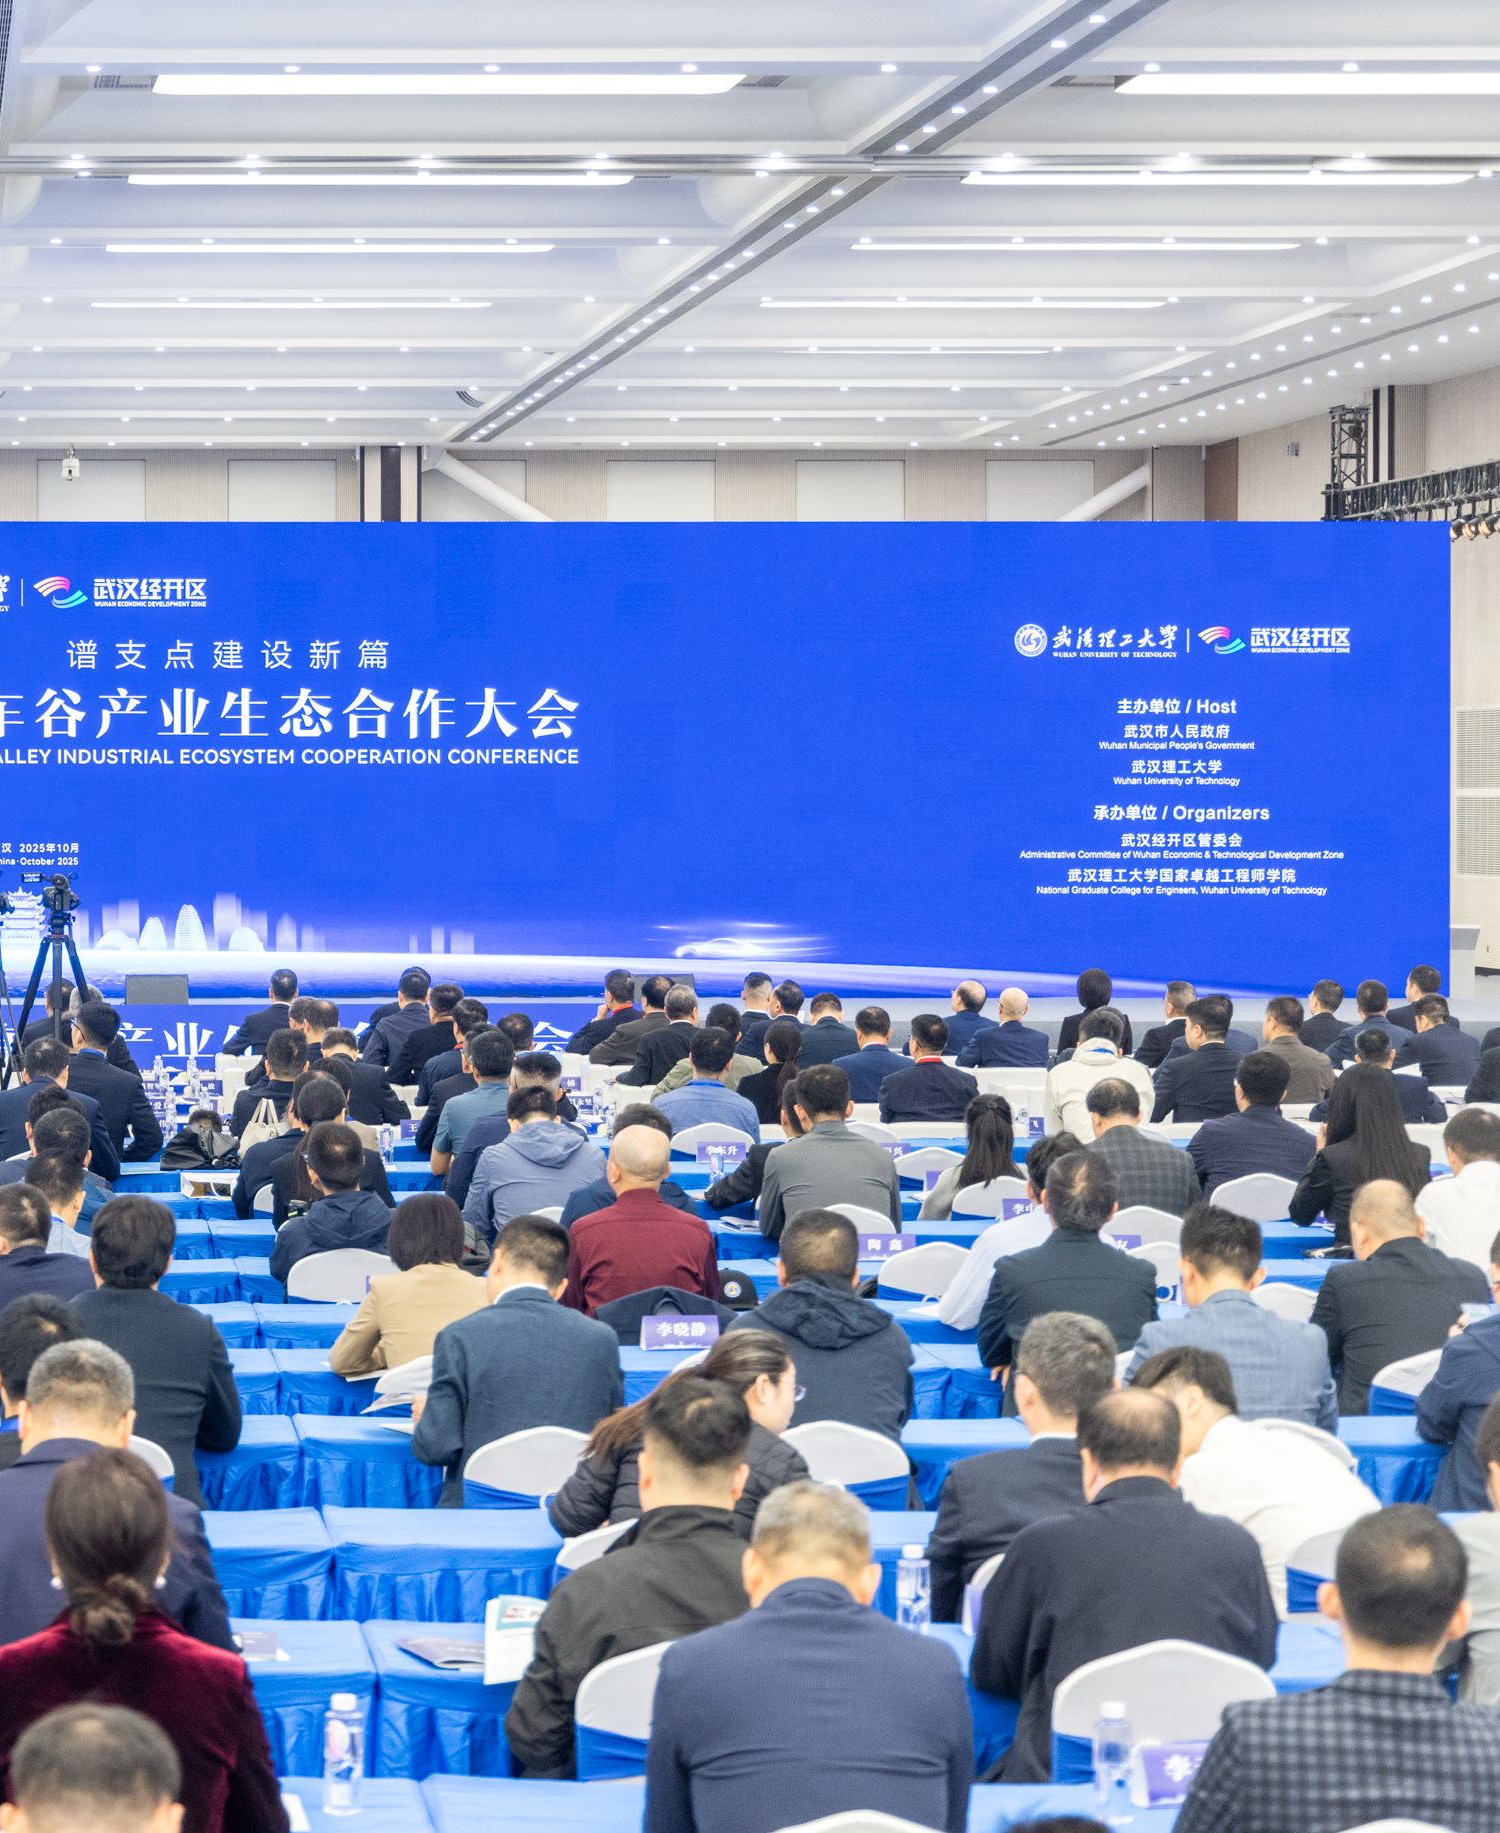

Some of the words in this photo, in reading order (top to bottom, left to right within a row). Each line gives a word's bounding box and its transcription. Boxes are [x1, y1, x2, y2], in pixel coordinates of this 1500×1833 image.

[93, 579, 207, 599] 武汉经开区
[147, 600, 190, 608] DEVELOPMENT
[1250, 627, 1351, 647] 武汉经开区
[66, 640, 389, 669] 谱支点建设新篇
[1117, 698, 1181, 715] 主办单位
[1196, 699, 1237, 714] Host
[1123, 723, 1230, 739] 武汉市人民政府
[1098, 741, 1128, 750] Wuhan
[1128, 741, 1168, 751] Municipal
[1168, 740, 1204, 751] People's
[1204, 740, 1255, 750] Government
[57, 748, 175, 765] INDUSTRIAL
[179, 748, 295, 765] ECOSYSTEM
[301, 748, 441, 765] COOPERATION
[447, 748, 579, 765] CONFERENCE
[1131, 759, 1222, 775] 武汉理工大学
[1113, 776, 1143, 785] Wuhan
[1143, 776, 1184, 787] University
[1184, 776, 1194, 785] of
[1194, 776, 1241, 787] Technology
[1093, 804, 1158, 821] 承办单位
[1172, 805, 1270, 823] Organizers
[19, 842, 79, 854] 2025年10月
[1120, 832, 1243, 848] 武汉经开区管委会
[57, 856, 79, 866] 2025
[1019, 850, 1077, 859] Administrative
[1077, 850, 1122, 859] Committee
[1122, 850, 1132, 859] of
[1132, 850, 1162, 859] Wuhan
[1162, 850, 1203, 859] Economic
[1212, 850, 1267, 861] Technological
[1268, 850, 1322, 861] Development
[1322, 850, 1345, 859] Zone
[1067, 867, 1297, 883] 武汉理工大学国家卓越工程师学院
[1036, 885, 1070, 895] National
[1071, 885, 1109, 895] Graduate
[1110, 885, 1142, 896] College
[1142, 885, 1155, 895] for
[1155, 885, 1199, 896] Engineers,
[1200, 885, 1230, 895] Wuhan
[1230, 886, 1271, 896] University
[1271, 885, 1281, 895] of
[1281, 885, 1328, 897] Technology
